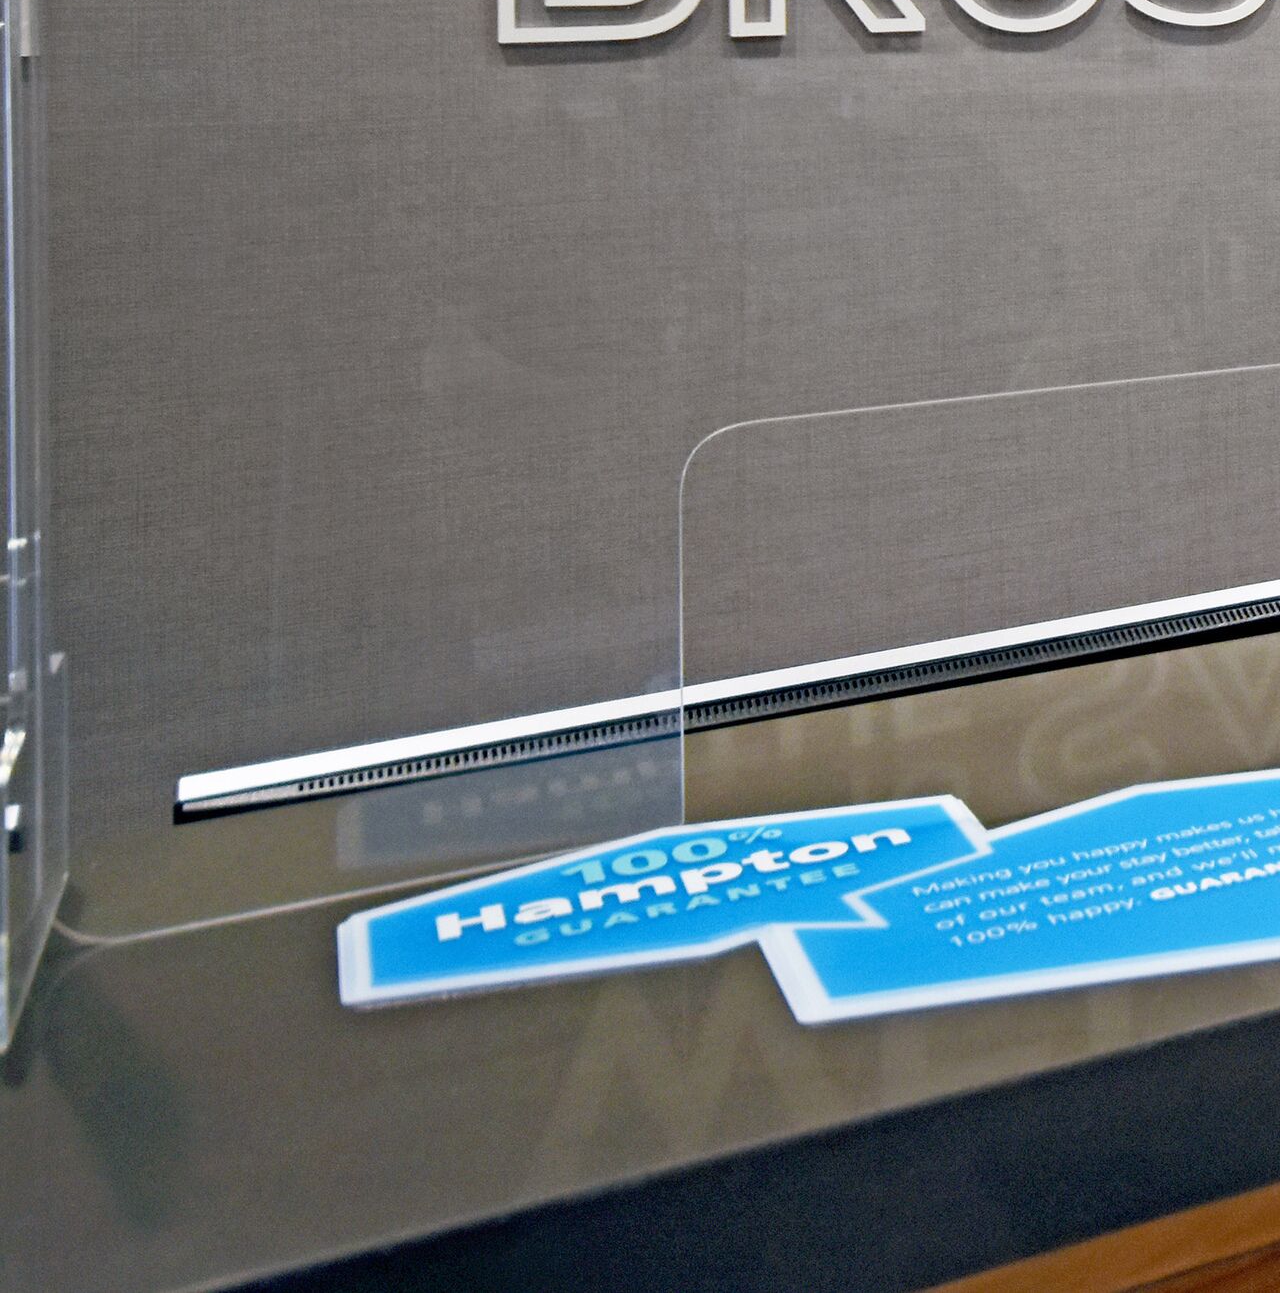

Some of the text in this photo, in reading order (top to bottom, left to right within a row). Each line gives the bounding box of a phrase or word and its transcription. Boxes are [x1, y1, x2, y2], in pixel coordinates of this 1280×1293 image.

[435, 826, 912, 942] Hampton
[562, 825, 783, 886] 100%
[912, 866, 1013, 897] Making
[1017, 856, 1066, 875] you
[1072, 838, 1149, 862] happy
[1156, 819, 1233, 844] makes
[1238, 813, 1265, 826] us
[924, 894, 972, 914] can
[979, 877, 1051, 902] make
[1056, 863, 1114, 885] your
[1119, 851, 1168, 871] stay
[1171, 833, 1251, 857] better,
[935, 912, 967, 931] of
[978, 901, 1028, 922] our
[1040, 881, 1124, 907] team,
[1131, 864, 1183, 888] and
[1191, 848, 1259, 873] we'll
[513, 862, 861, 947] GUARANTEE
[951, 918, 1039, 948] 100%
[1047, 896, 1142, 926] happy.
